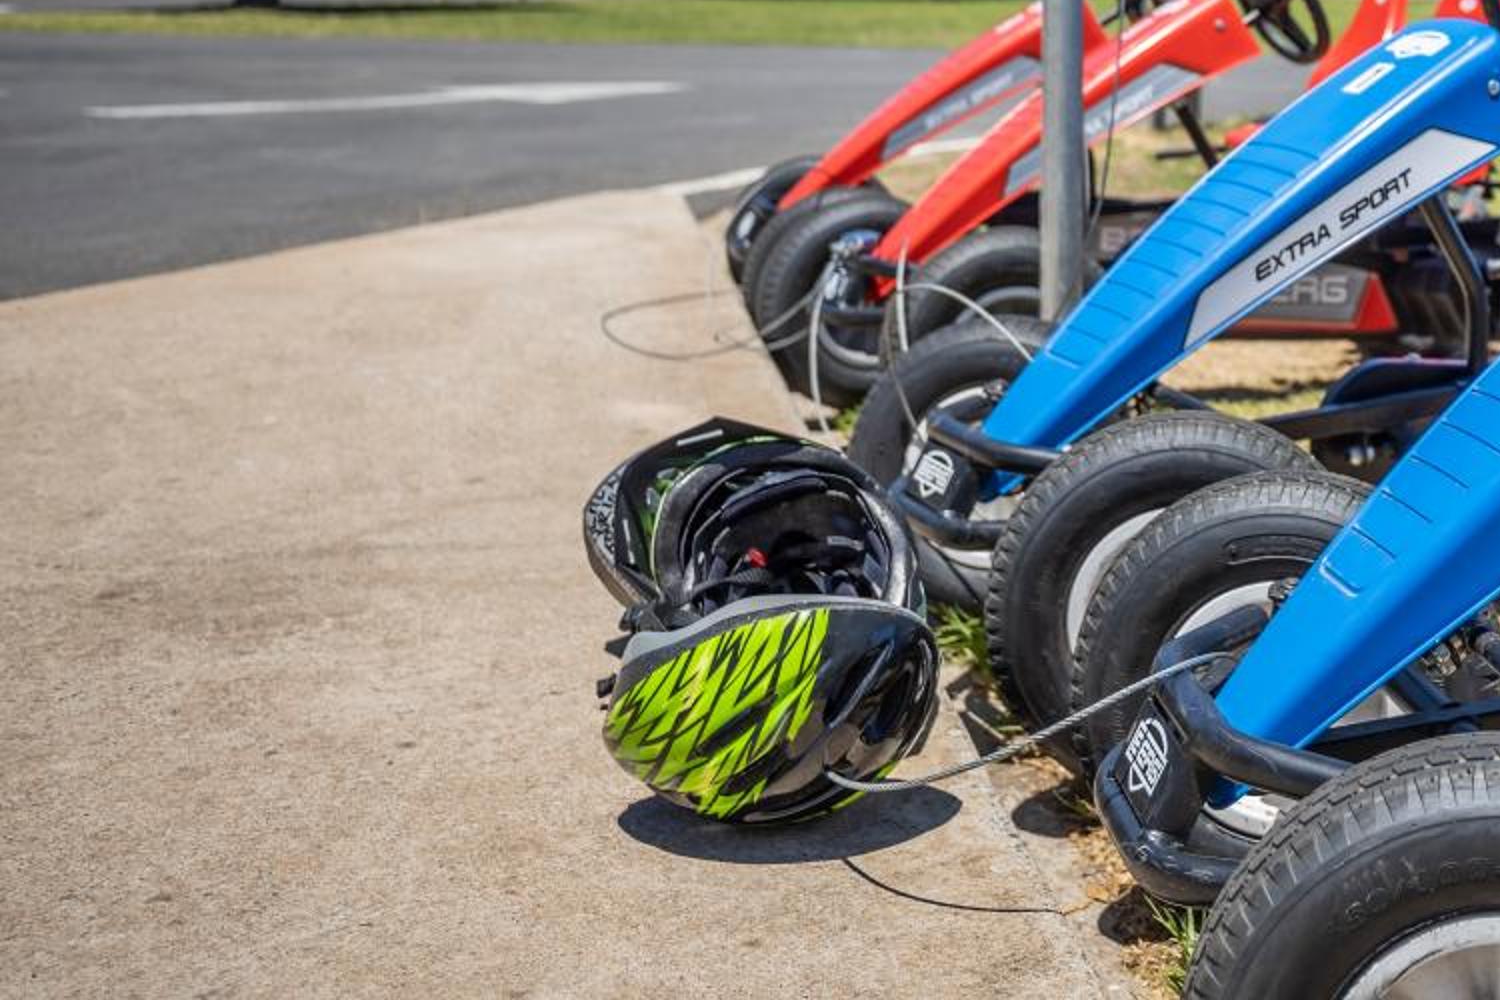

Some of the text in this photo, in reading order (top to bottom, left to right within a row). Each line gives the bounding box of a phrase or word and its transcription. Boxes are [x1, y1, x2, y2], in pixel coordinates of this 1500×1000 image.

[1255, 168, 1412, 281] EXTRA SPORT
[1272, 275, 1347, 304] RG
